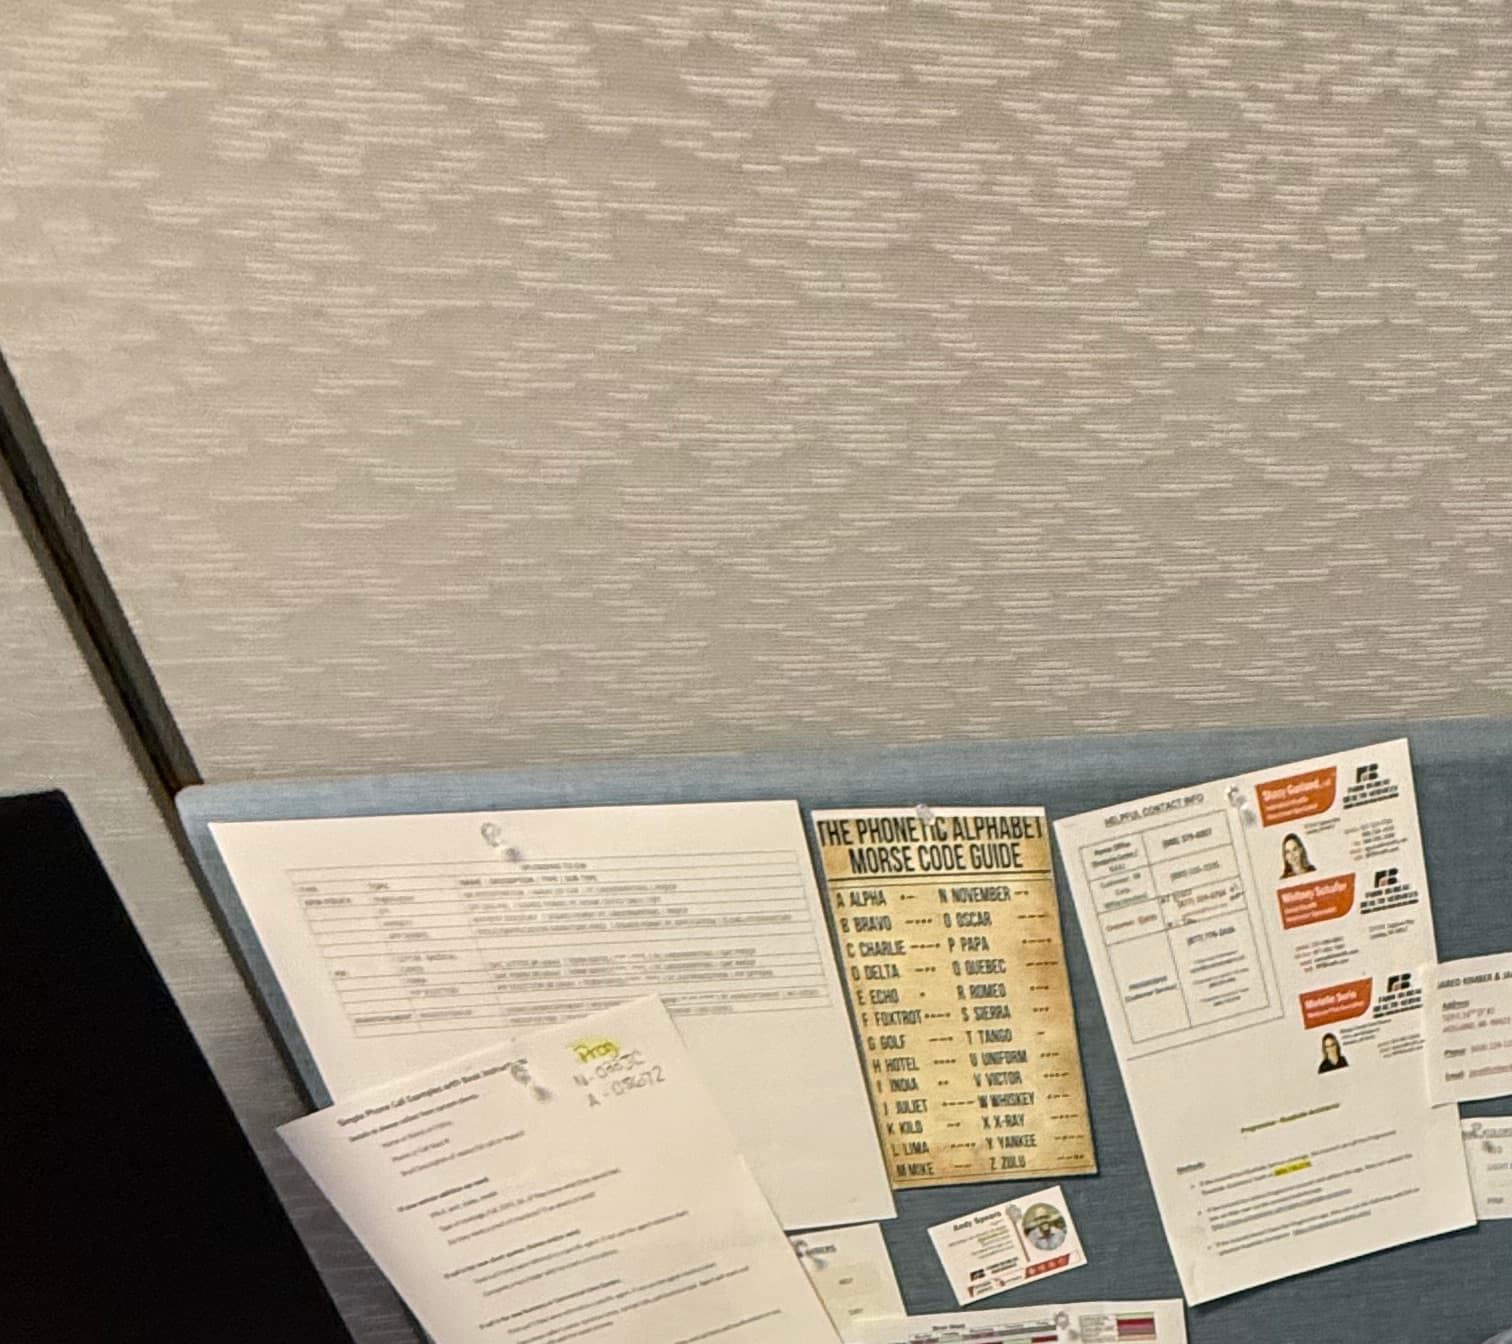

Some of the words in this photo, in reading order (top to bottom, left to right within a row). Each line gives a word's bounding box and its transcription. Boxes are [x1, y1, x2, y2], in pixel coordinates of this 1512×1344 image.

[1104, 809, 1140, 828] HELPFUL
[1142, 798, 1182, 816] CONTACT
[1183, 793, 1205, 807] INFO
[817, 820, 853, 846] THE
[856, 817, 947, 843] PHONETIC
[952, 816, 1043, 841] ALPHABET
[849, 845, 915, 874] MORSE
[918, 844, 966, 871] CODE
[970, 843, 1023, 868] GUIDE
[836, 894, 845, 907] A
[851, 890, 886, 906] ALPHA
[939, 888, 948, 904] N
[952, 887, 1011, 903] NOVEMBER
[842, 918, 850, 933] B
[856, 916, 891, 931] BRAVO
[956, 912, 992, 927] OSCAR
[847, 943, 855, 958] C
[861, 941, 906, 957] CHARLIE
[948, 937, 955, 952] P
[961, 936, 989, 951] PAPA
[866, 965, 900, 979] DELTA
[966, 959, 1006, 974] QUEBEC
[858, 991, 865, 1005] E
[871, 989, 899, 1003] ECHO
[957, 986, 966, 1000] R
[970, 983, 1006, 998] ROMEO
[862, 1013, 868, 1027] F
[875, 1010, 921, 1025] FOXTROT
[962, 1007, 969, 1021] S
[975, 1006, 1010, 1020] SIERRA
[867, 1037, 875, 1051] G
[880, 1035, 906, 1049] GOLF
[966, 1031, 972, 1044] T
[978, 1029, 1012, 1043] TANGO
[874, 1059, 881, 1073] H
[886, 1057, 919, 1071] HOTEL
[970, 1053, 977, 1066] U
[982, 1050, 1027, 1065] UNIFORM
[974, 1074, 981, 1087] V
[986, 1071, 1022, 1086] VICTOR
[991, 1092, 1034, 1107] WHISKEY
[887, 1123, 895, 1135] K
[983, 1116, 990, 1129] X
[995, 1114, 1025, 1128] X-RAY
[904, 1141, 929, 1155] LIMA
[986, 1138, 993, 1150] Y
[1000, 1135, 1037, 1149] YANKEE
[897, 1164, 906, 1177] M
[907, 1162, 934, 1176] MIKE
[990, 1157, 997, 1170] Z
